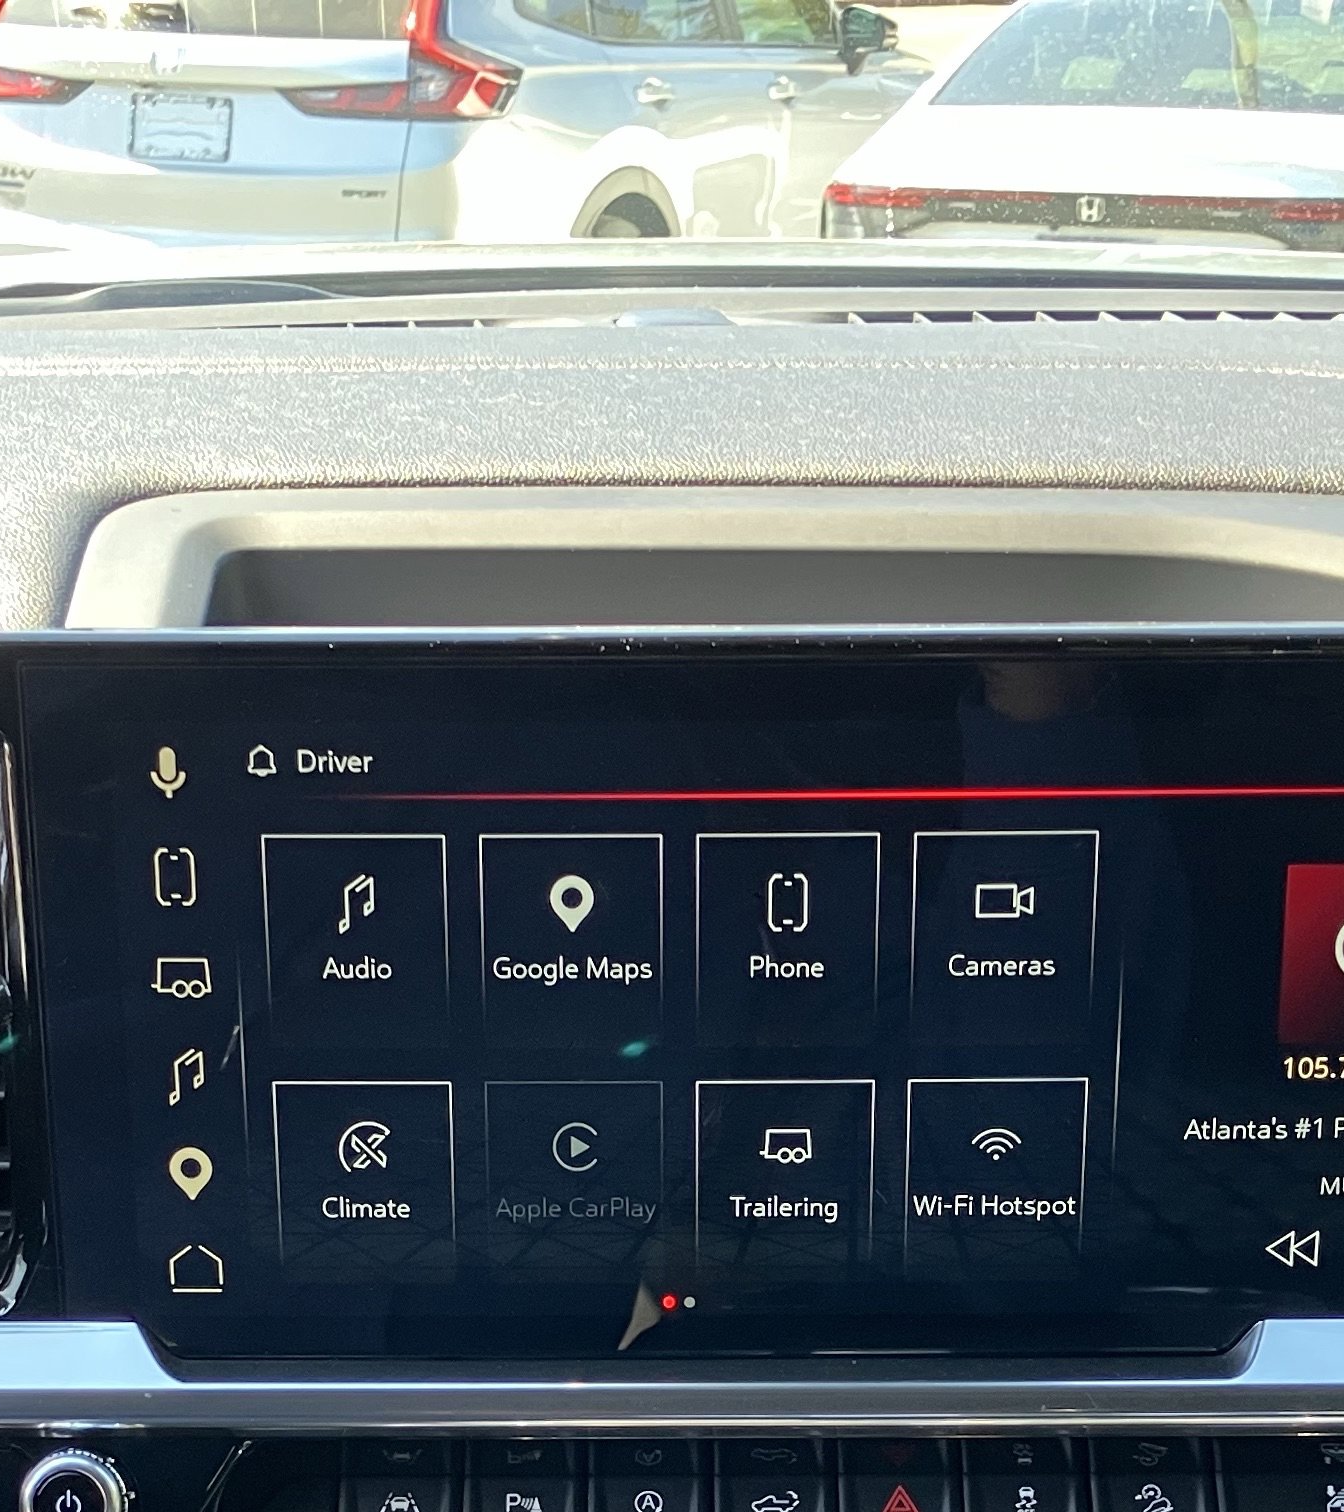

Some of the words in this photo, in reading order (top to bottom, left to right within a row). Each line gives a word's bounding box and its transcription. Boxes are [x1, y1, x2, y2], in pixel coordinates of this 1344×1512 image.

[296, 749, 373, 774] Driver
[322, 956, 393, 980] Audio
[492, 956, 579, 986] Google
[586, 956, 654, 986] Maps
[749, 955, 825, 979] Phone
[947, 953, 1056, 977] Cameras
[1183, 1117, 1289, 1141] Atlanta's
[1294, 1117, 1324, 1140] #1
[321, 1196, 412, 1221] Climate
[495, 1197, 562, 1223] Apple
[568, 1197, 656, 1222] CarPlay
[729, 1195, 839, 1223] Trailering
[912, 1194, 974, 1217] Wi-Fi
[981, 1194, 1077, 1222] Hotspot
